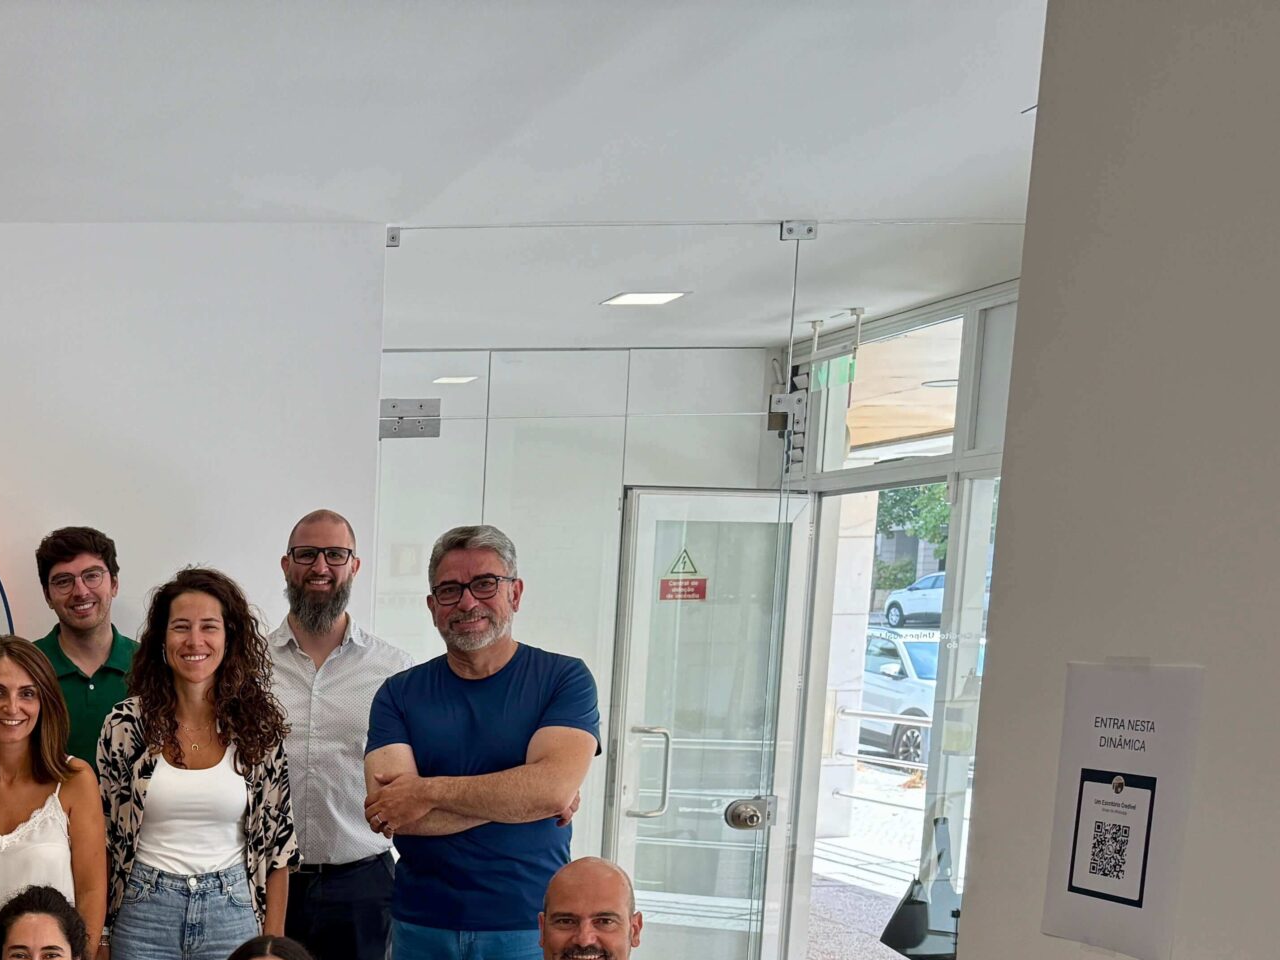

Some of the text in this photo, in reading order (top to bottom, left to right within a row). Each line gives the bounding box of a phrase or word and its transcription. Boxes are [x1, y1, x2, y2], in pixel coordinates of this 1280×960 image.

[1093, 716, 1156, 733] ENTRA NESTA
[1099, 734, 1147, 753] DINÂMICA
